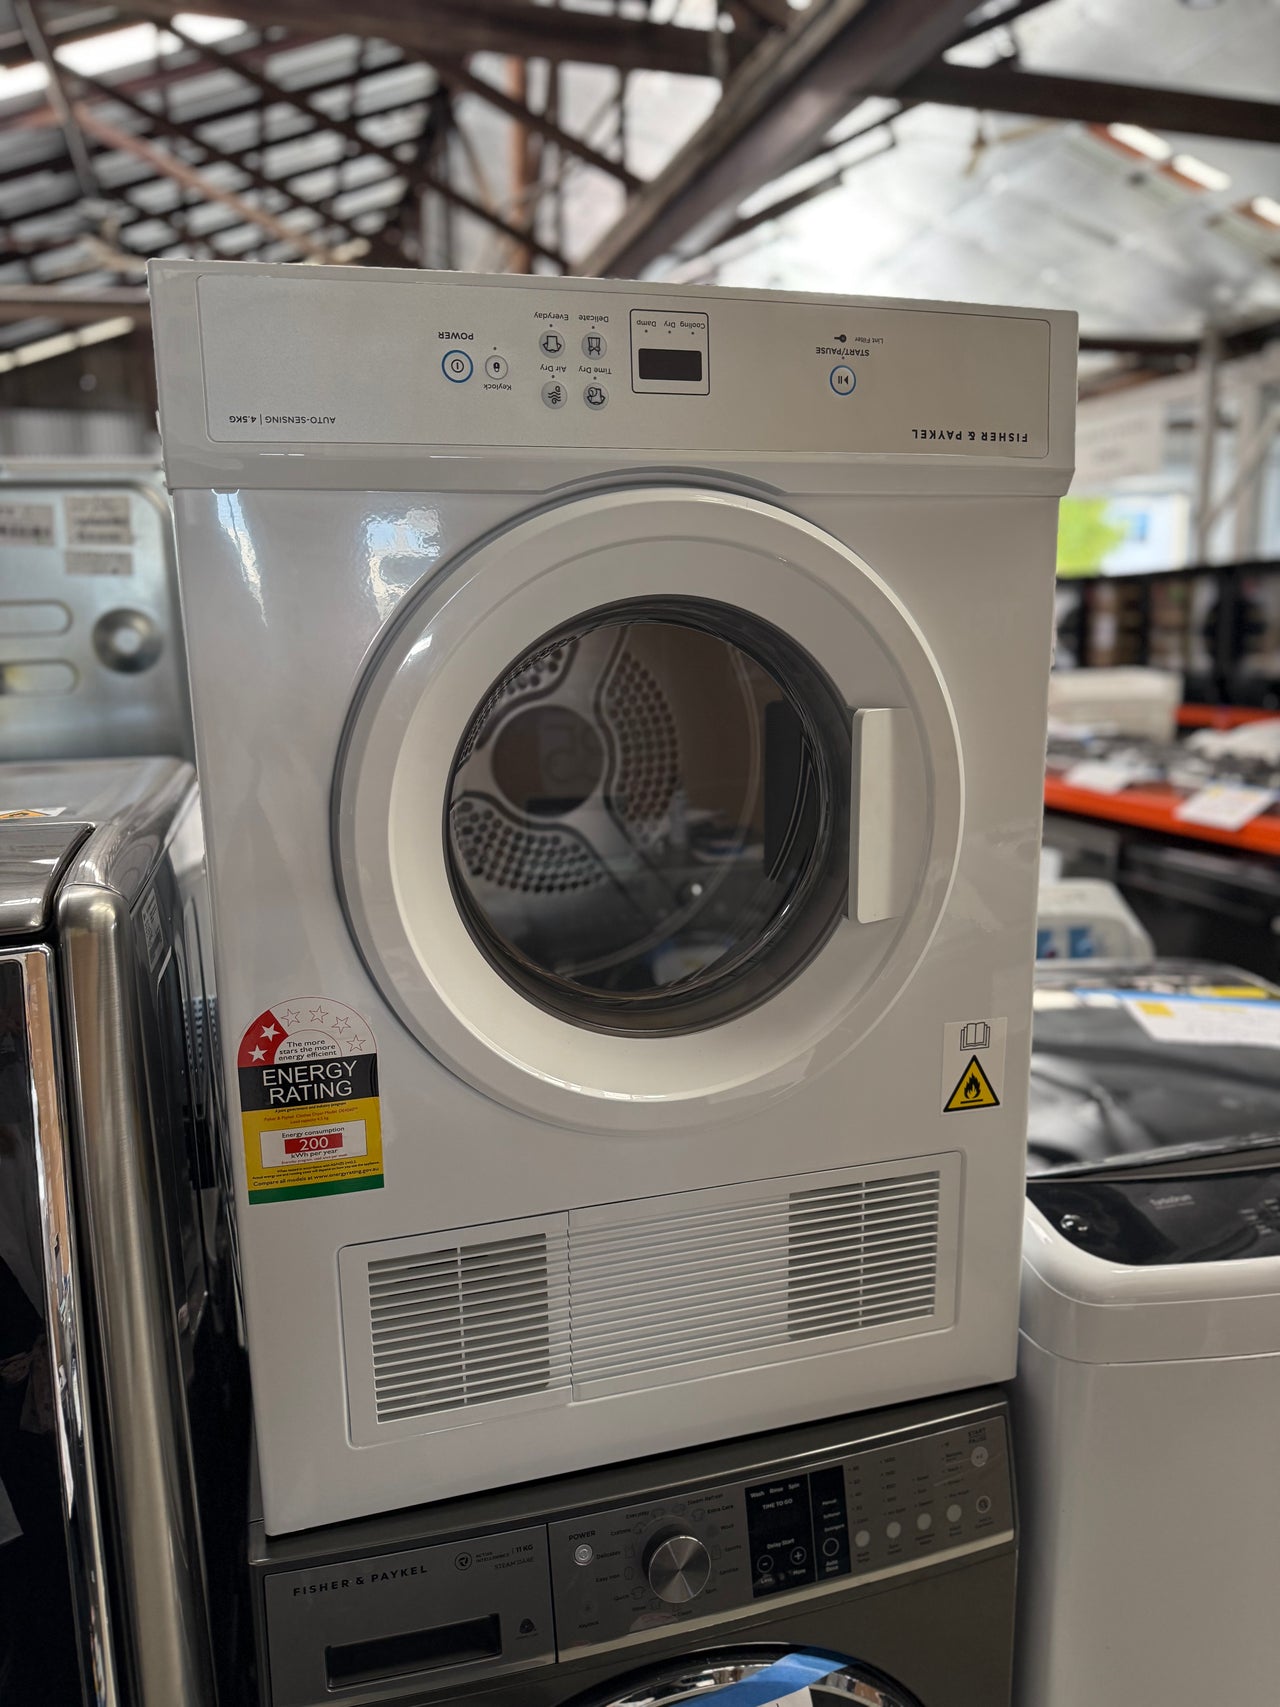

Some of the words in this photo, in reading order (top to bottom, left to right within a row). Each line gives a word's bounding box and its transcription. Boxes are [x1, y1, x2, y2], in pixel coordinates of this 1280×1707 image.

[534, 311, 569, 321] Everyday
[578, 314, 609, 322] Delicate
[664, 320, 676, 328] Dry
[679, 320, 706, 330] Cooling
[438, 331, 474, 340] POWER
[815, 346, 870, 357] START/PAUSE
[539, 363, 553, 372] Dry
[554, 365, 567, 373] Air
[578, 365, 592, 374] Dry
[483, 383, 512, 391] Keylock
[229, 415, 257, 423] 4.5KG
[265, 416, 336, 424] AUTO-SENSING
[911, 428, 962, 440] PAYKEL
[968, 431, 976, 440] &
[981, 431, 1029, 443] FISHER
[286, 1040, 303, 1048] The
[278, 1053, 305, 1062] energy
[306, 1050, 337, 1059] efficient
[262, 1060, 358, 1087] ENERGY
[269, 1080, 353, 1105] RATING
[281, 1131, 304, 1139] Energy
[304, 1126, 345, 1137] consumption
[299, 1136, 329, 1152] 200
[290, 1151, 309, 1159] kWh
[309, 1150, 323, 1158] per
[323, 1149, 338, 1157] year
[762, 1502, 776, 1510] TIME
[784, 1498, 793, 1506] GO
[568, 1530, 596, 1542] POWER
[293, 1579, 350, 1597] FISHER
[355, 1576, 365, 1585] &
[371, 1565, 428, 1583] PAYKEL
